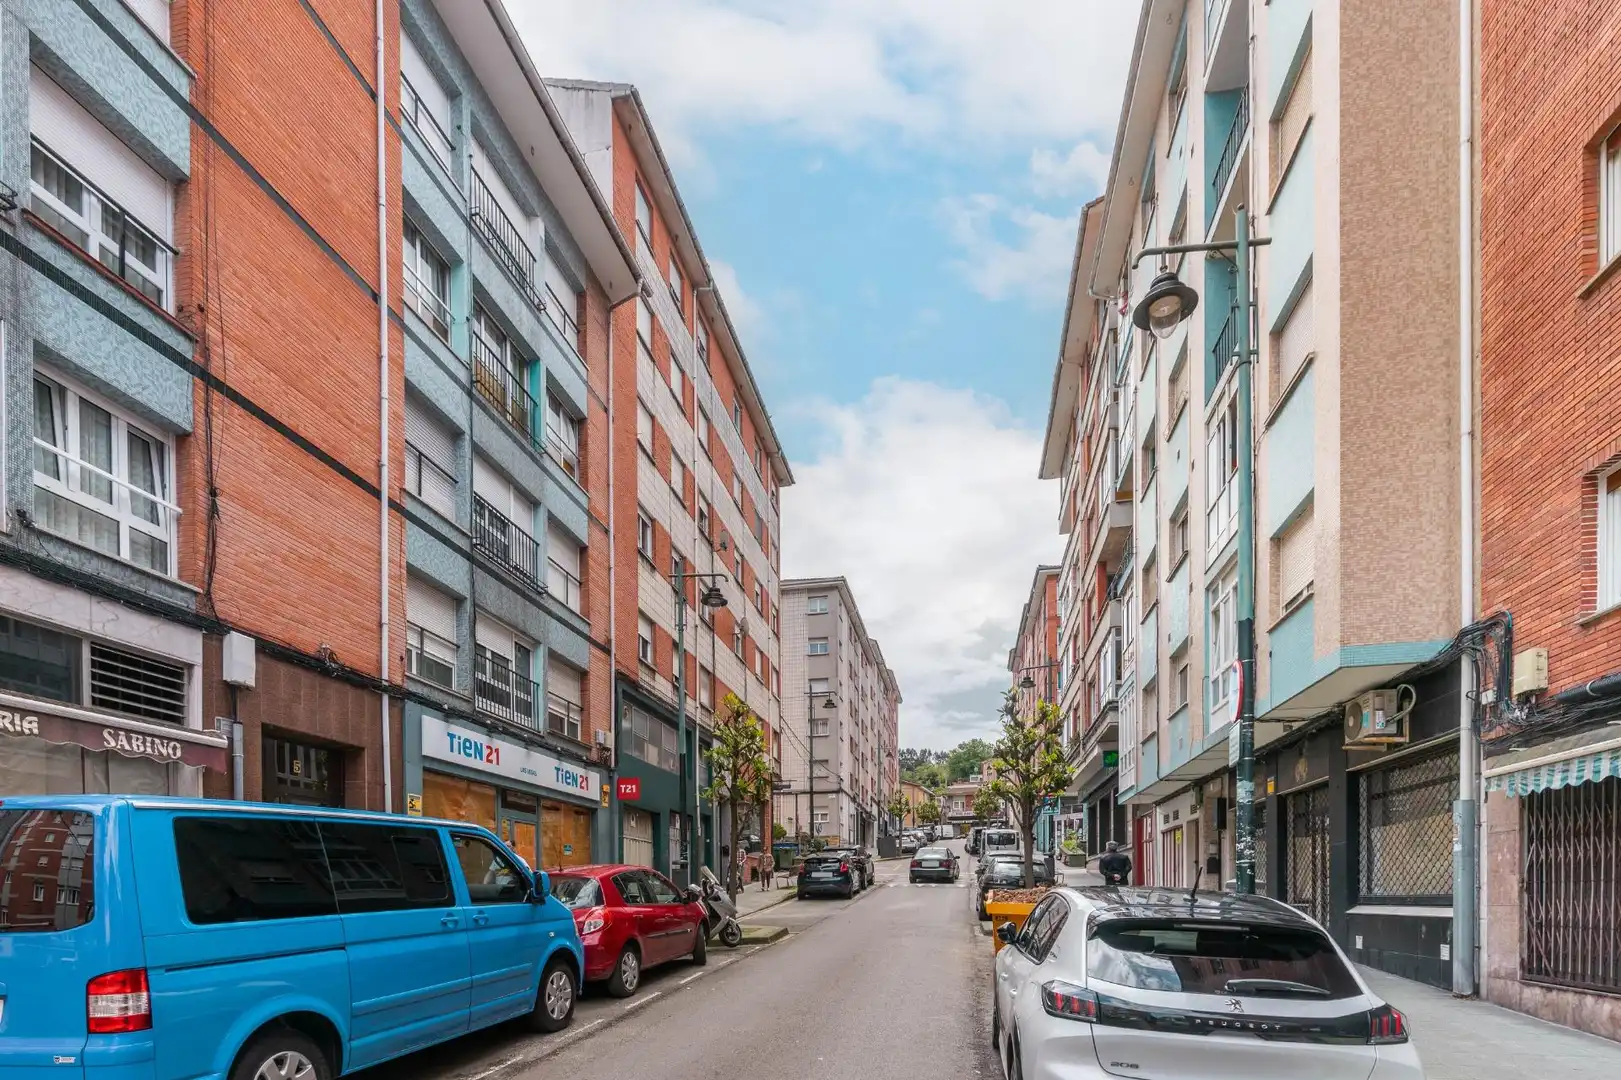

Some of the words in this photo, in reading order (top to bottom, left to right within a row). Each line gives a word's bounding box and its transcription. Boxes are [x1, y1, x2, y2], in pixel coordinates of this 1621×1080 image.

[102, 728, 182, 759] SABINO
[620, 784, 636, 793] T21
[1195, 1019, 1281, 1030] PEUGEOT
